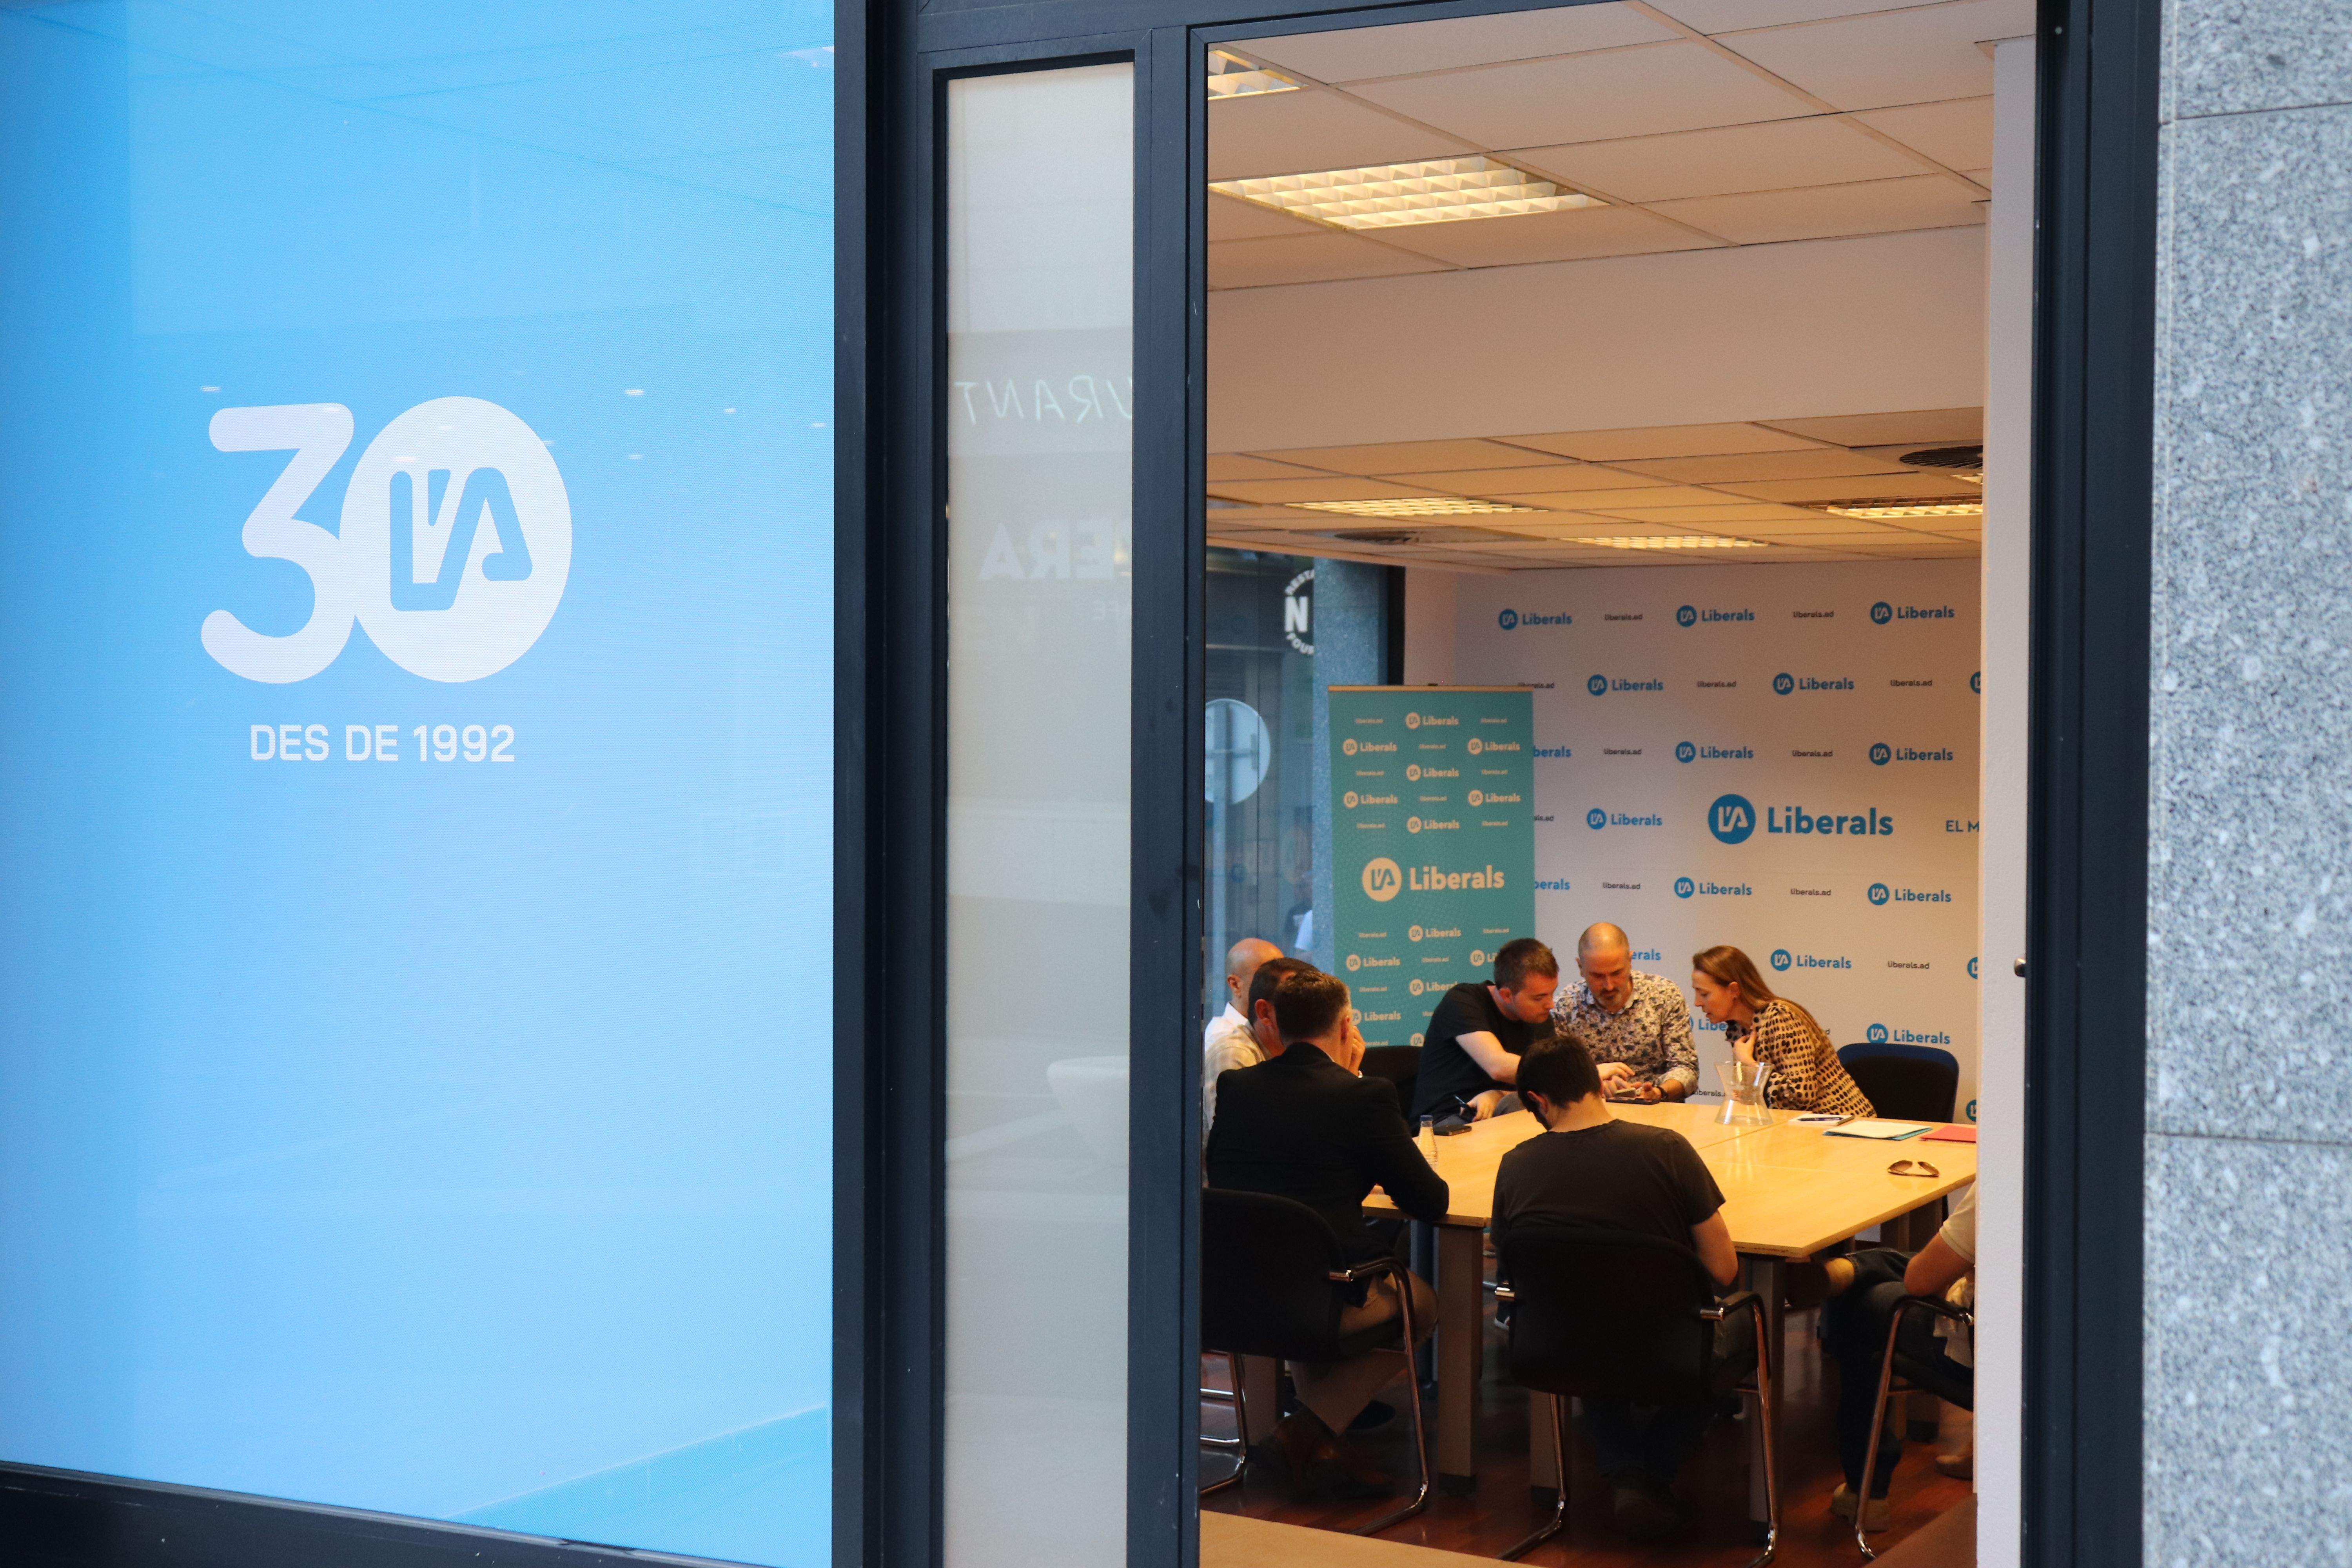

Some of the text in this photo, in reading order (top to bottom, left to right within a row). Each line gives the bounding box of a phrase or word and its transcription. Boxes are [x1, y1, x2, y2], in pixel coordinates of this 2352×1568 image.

[1702, 610, 1754, 621] Liberals
[1898, 606, 1954, 618] Liberals
[1523, 613, 1572, 624] Liberals
[1612, 680, 1663, 691] Liberals
[1799, 677, 1854, 690] Liberals
[1423, 716, 1459, 725] Liberals
[250, 724, 515, 762] DES DE 1992
[1360, 743, 1397, 751] Liberals
[1485, 742, 1520, 751] Liberals
[1533, 746, 1572, 757] berals
[1700, 747, 1753, 758] Liberals
[1896, 748, 1953, 760] Liberals
[1424, 768, 1459, 777] Liberals
[1361, 795, 1398, 804] Liberals
[1486, 793, 1521, 802] Liberals
[1425, 820, 1460, 829] Liberals
[1611, 814, 1662, 826] Liberals
[1768, 807, 1893, 835] Liberals
[1946, 820, 1963, 832] EL
[1410, 865, 1504, 890] Liberals
[1535, 878, 1570, 890] berals
[1699, 883, 1752, 895] Liberals
[1895, 889, 1951, 902] Liberals
[1426, 928, 1461, 937] Liberals
[1632, 949, 1661, 961] erals
[1363, 956, 1400, 967] Liberals
[1797, 955, 1851, 969] Liberals
[1888, 961, 1929, 969] liberals.ad
[1364, 1010, 1401, 1021] Liberals
[1699, 1019, 1727, 1031] Libe
[1894, 1030, 1950, 1044] Liberals
